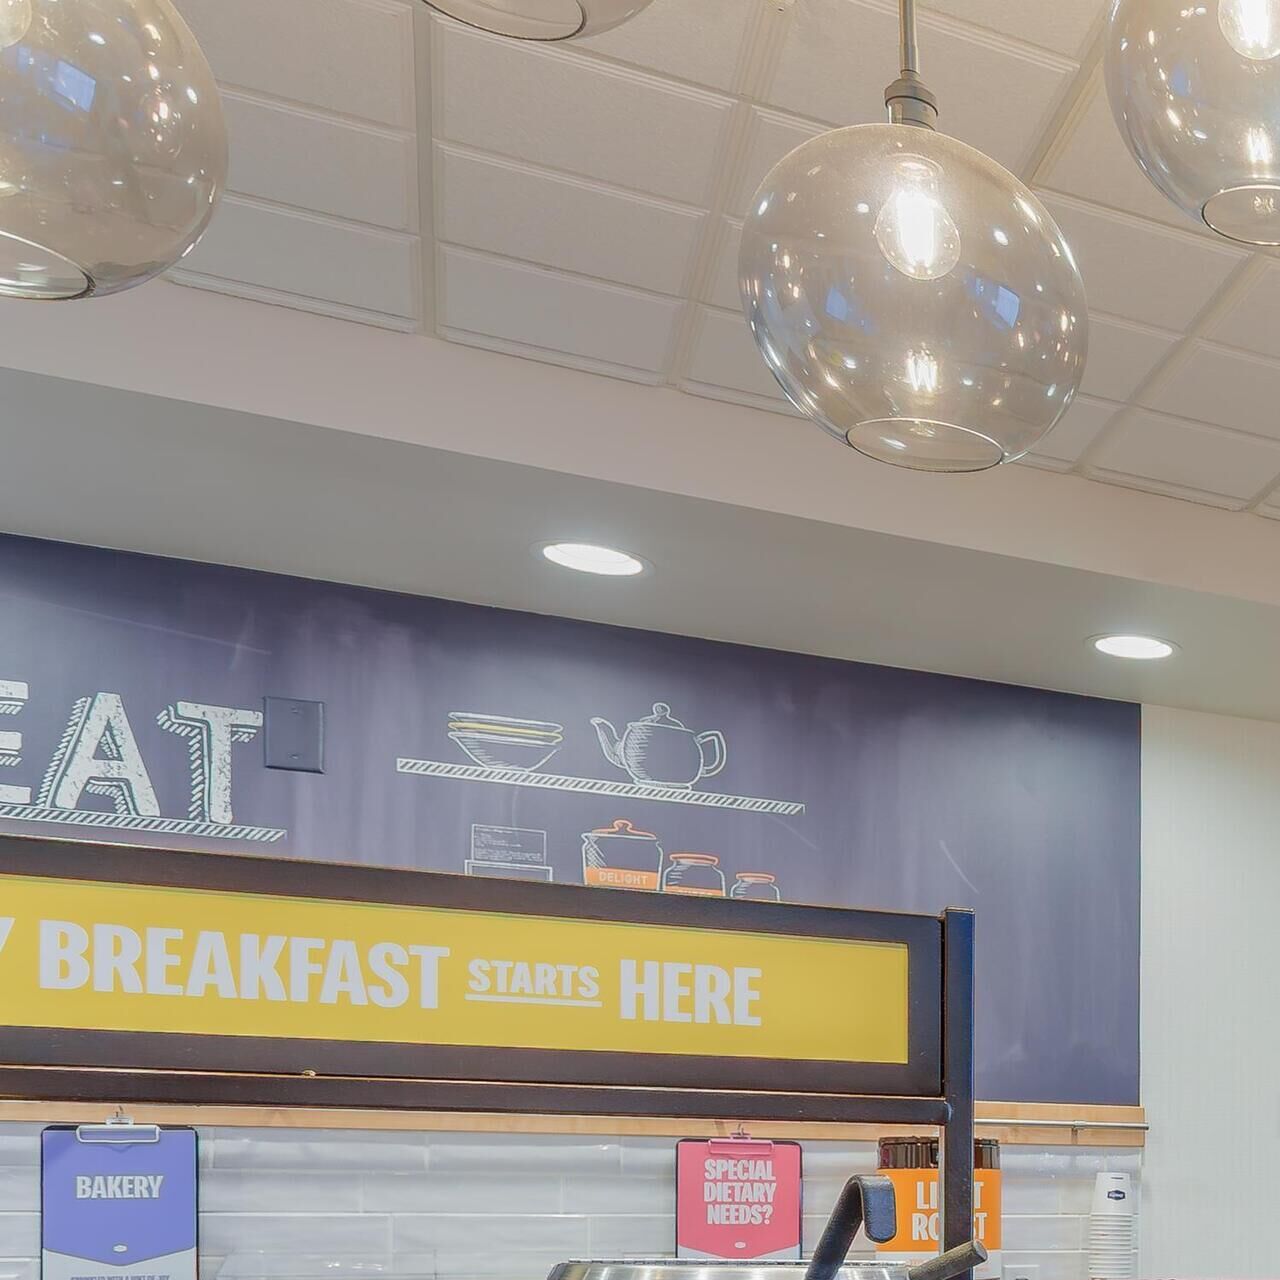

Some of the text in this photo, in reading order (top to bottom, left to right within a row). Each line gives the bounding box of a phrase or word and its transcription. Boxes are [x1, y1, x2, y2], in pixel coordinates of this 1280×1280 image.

[598, 871, 649, 886] DELIGHT
[39, 918, 450, 1010] BREAKFAST
[467, 958, 600, 999] STARTS
[620, 960, 763, 1028] HERE
[704, 1158, 777, 1181] SPECIAL
[76, 1175, 164, 1199] BAKERY
[703, 1181, 777, 1203] DIETARY
[916, 1181, 984, 1209] LIT
[707, 1203, 774, 1225] NEEDS?
[912, 1212, 988, 1241] ROT
